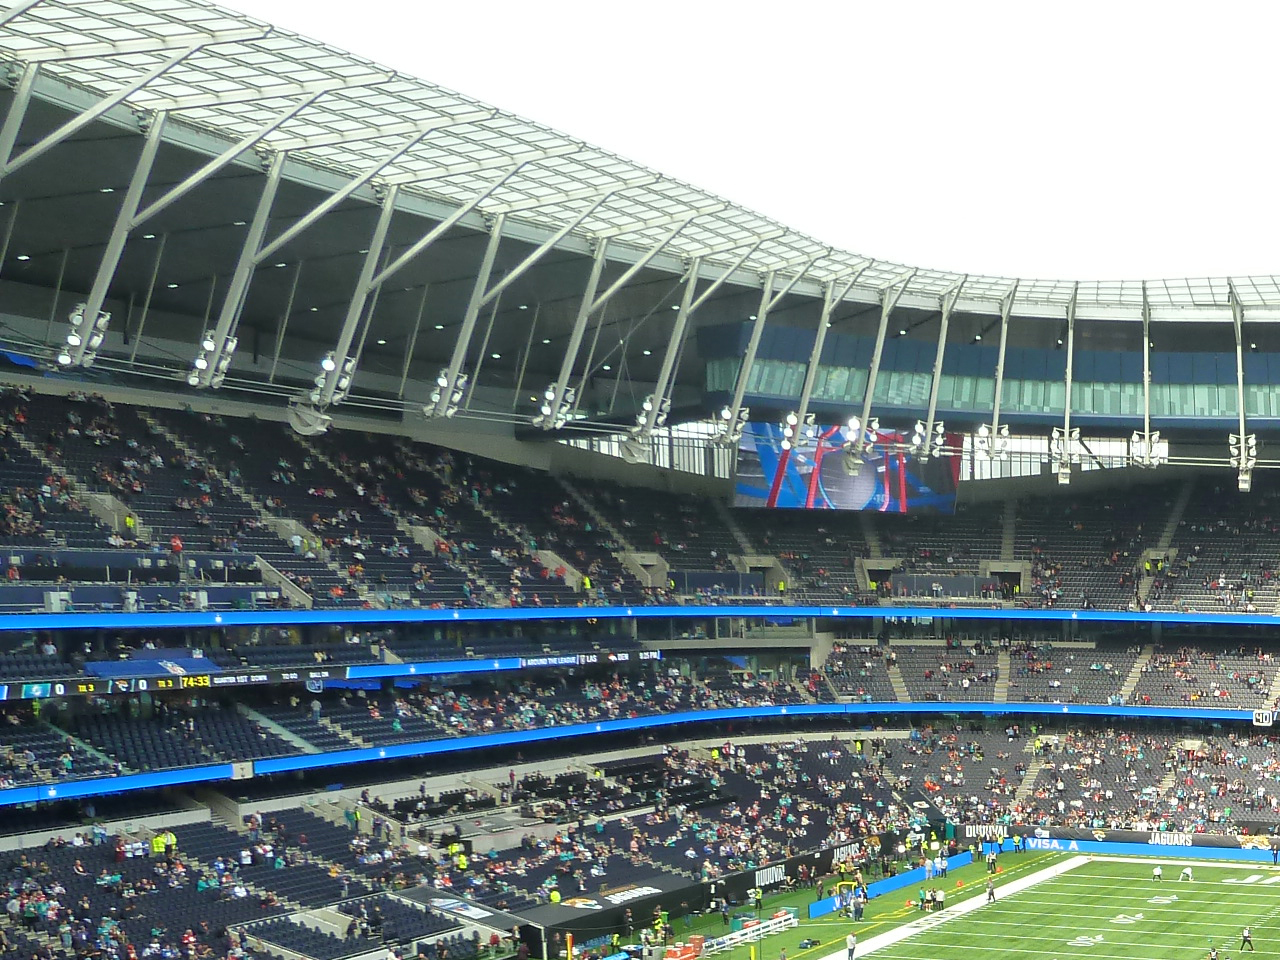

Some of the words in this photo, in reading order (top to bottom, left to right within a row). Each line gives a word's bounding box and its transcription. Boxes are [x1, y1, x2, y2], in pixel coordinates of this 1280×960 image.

[558, 656, 577, 664] LEAGUE
[586, 655, 597, 663] LAS
[138, 679, 147, 690] 0
[182, 676, 209, 687] 74:33
[55, 683, 64, 694] 0
[1255, 713, 1271, 724] 40
[1148, 832, 1193, 846] JAGUARS
[1069, 841, 1079, 850] A
